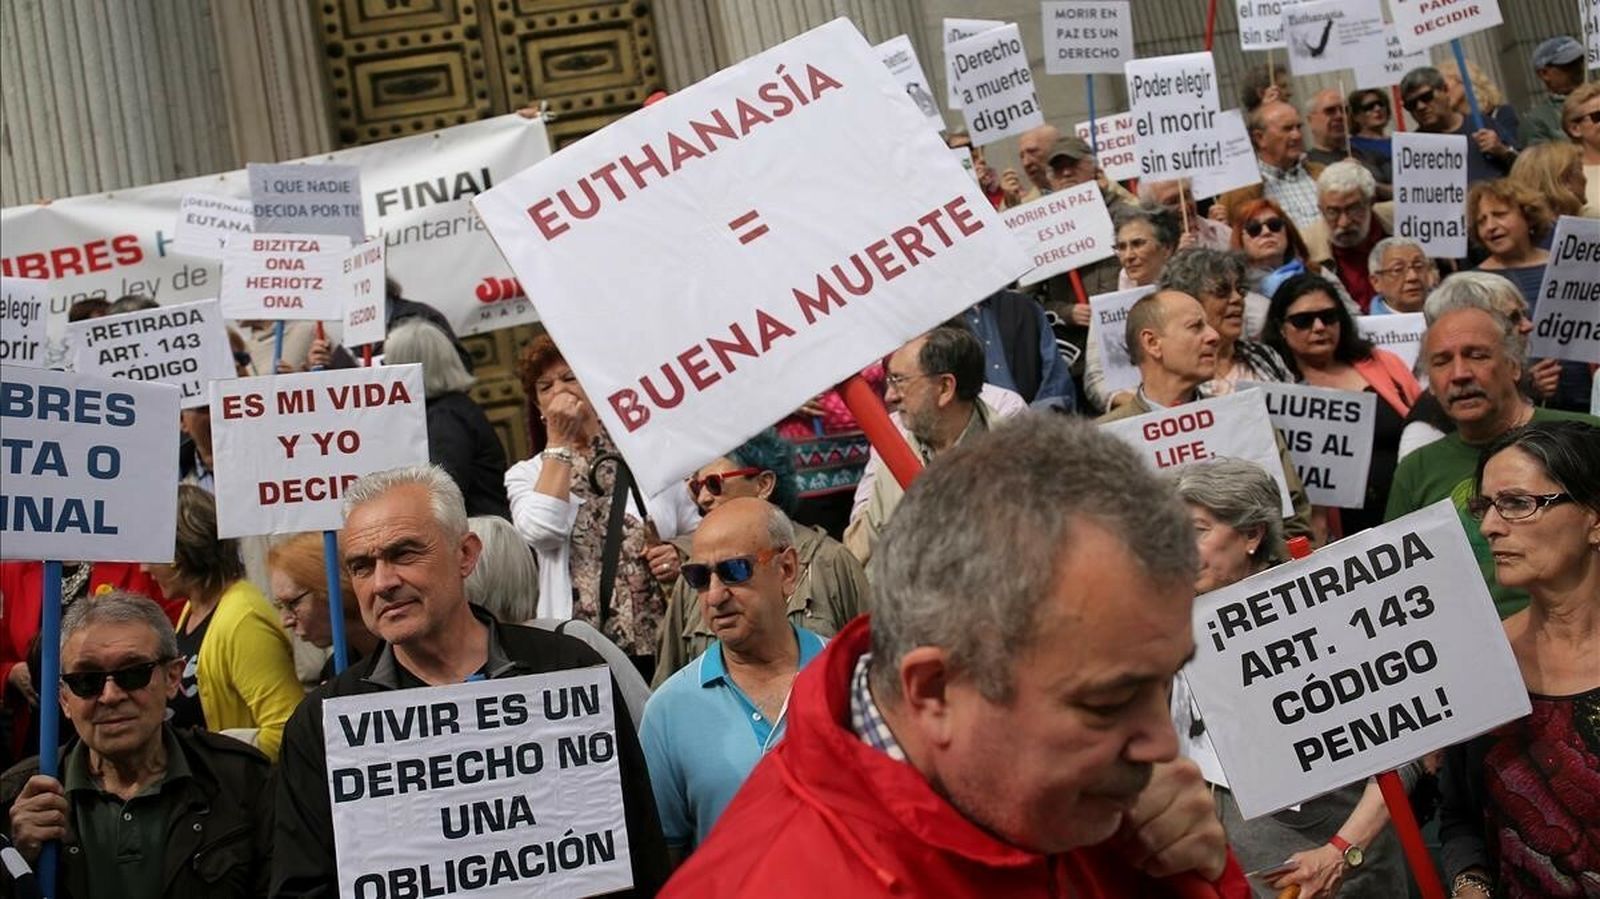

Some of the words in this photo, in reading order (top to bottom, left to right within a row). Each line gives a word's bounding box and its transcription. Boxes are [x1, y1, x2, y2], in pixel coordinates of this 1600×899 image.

[1055, 8, 1097, 19] MORIR
[1101, 8, 1118, 19] EN
[1414, 5, 1480, 35] DECIDIR
[1057, 28, 1079, 39] PAZ
[1083, 28, 1097, 39] ES
[1100, 28, 1118, 39] UN
[952, 39, 1021, 81] ¡Derecho
[1059, 48, 1120, 59] DERECHO
[962, 89, 974, 104] a
[976, 67, 1030, 100] muerte
[1130, 73, 1172, 105] ¡Poder
[1175, 67, 1211, 98] elegir
[973, 92, 1040, 133] digna!
[1136, 111, 1154, 136] el
[1161, 105, 1215, 134] morir
[526, 63, 843, 241] EUTHANASÍA
[1103, 152, 1134, 168] POR
[1141, 149, 1167, 174] sin
[1172, 141, 1223, 170] sufrir!
[1397, 146, 1463, 175] ¡Derecho
[273, 180, 305, 194] QUE
[307, 180, 351, 193] NADIE
[1400, 186, 1408, 203] a
[1412, 184, 1464, 203] muerte
[254, 204, 307, 218] DECIDA
[311, 204, 341, 217] POR
[1004, 206, 1047, 229] MORIR
[1048, 199, 1068, 214] EN
[1068, 190, 1096, 207] PAZ
[1038, 227, 1054, 241] ES
[1055, 220, 1076, 235] UN
[1400, 215, 1467, 243] digna!
[253, 240, 320, 252] BIZITZA
[1033, 236, 1096, 267] DERECHO
[172, 263, 208, 291] de
[265, 257, 306, 271] ONA
[246, 276, 324, 290] HERIOTZ
[1546, 279, 1558, 299] a
[263, 295, 304, 309] ONA
[607, 309, 796, 433] BUENA
[792, 195, 985, 324] MUERTE
[86, 309, 204, 347] ¡RETIRADA
[99, 343, 148, 365] ART.
[158, 333, 201, 353] 143
[223, 393, 265, 420] ES
[277, 388, 315, 416] MI
[327, 381, 411, 409] VIDA
[1143, 409, 1215, 441] GOOD
[277, 434, 300, 458] Y
[311, 430, 360, 456] YO
[1321, 434, 1354, 457] AL
[87, 445, 121, 480] O
[1207, 532, 1434, 652] ¡RETIRADA
[1241, 628, 1337, 687] ART.
[1349, 584, 1435, 640] 143
[1273, 640, 1438, 726] CÓDIGO
[338, 702, 460, 747] VIVIR
[476, 693, 528, 730] ES
[543, 684, 600, 720] UN
[1293, 687, 1453, 772] PENAL!
[333, 742, 543, 803] DERECHO
[558, 732, 614, 769] NO
[440, 795, 536, 839] UNA
[353, 828, 615, 899] OBLIGACIÓN
